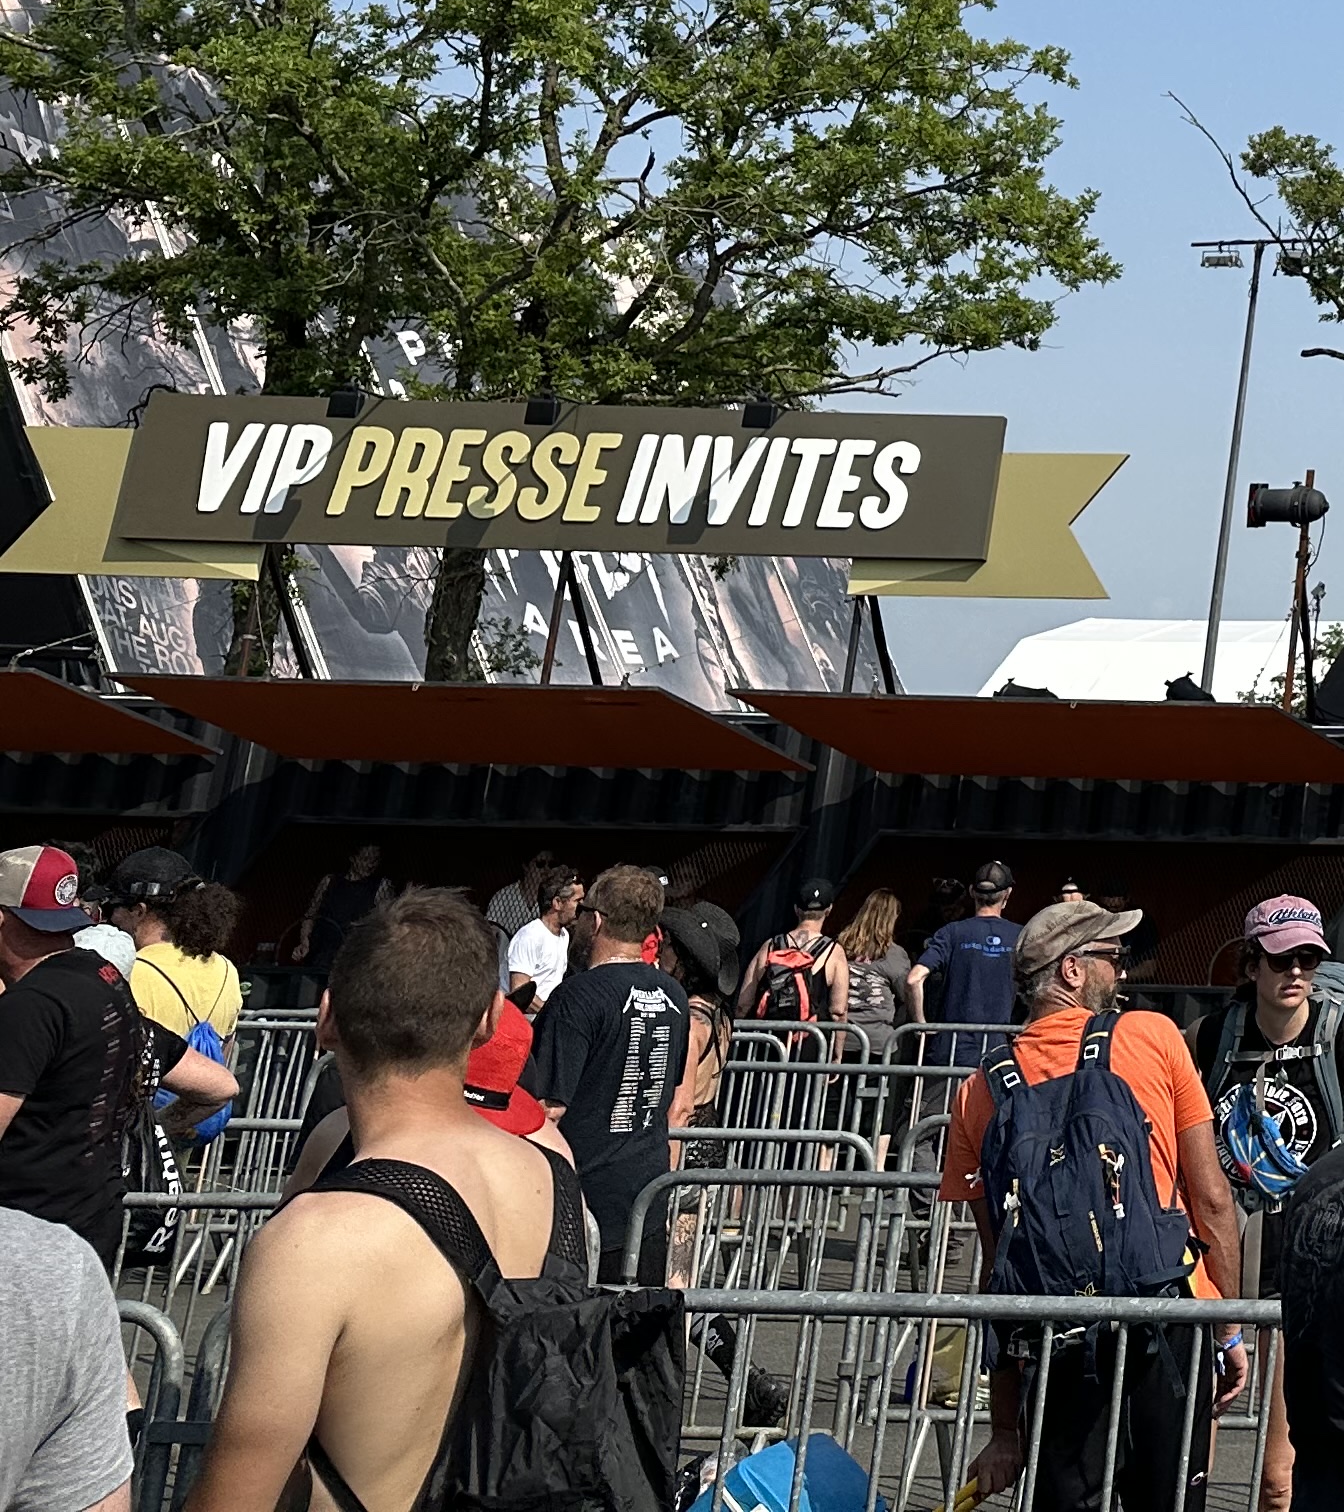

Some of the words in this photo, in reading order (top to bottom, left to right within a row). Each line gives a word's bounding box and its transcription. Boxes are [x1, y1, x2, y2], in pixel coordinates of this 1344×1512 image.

[196, 421, 334, 514] VIP
[325, 424, 624, 523] PRESSE
[616, 433, 922, 531] INVITES
